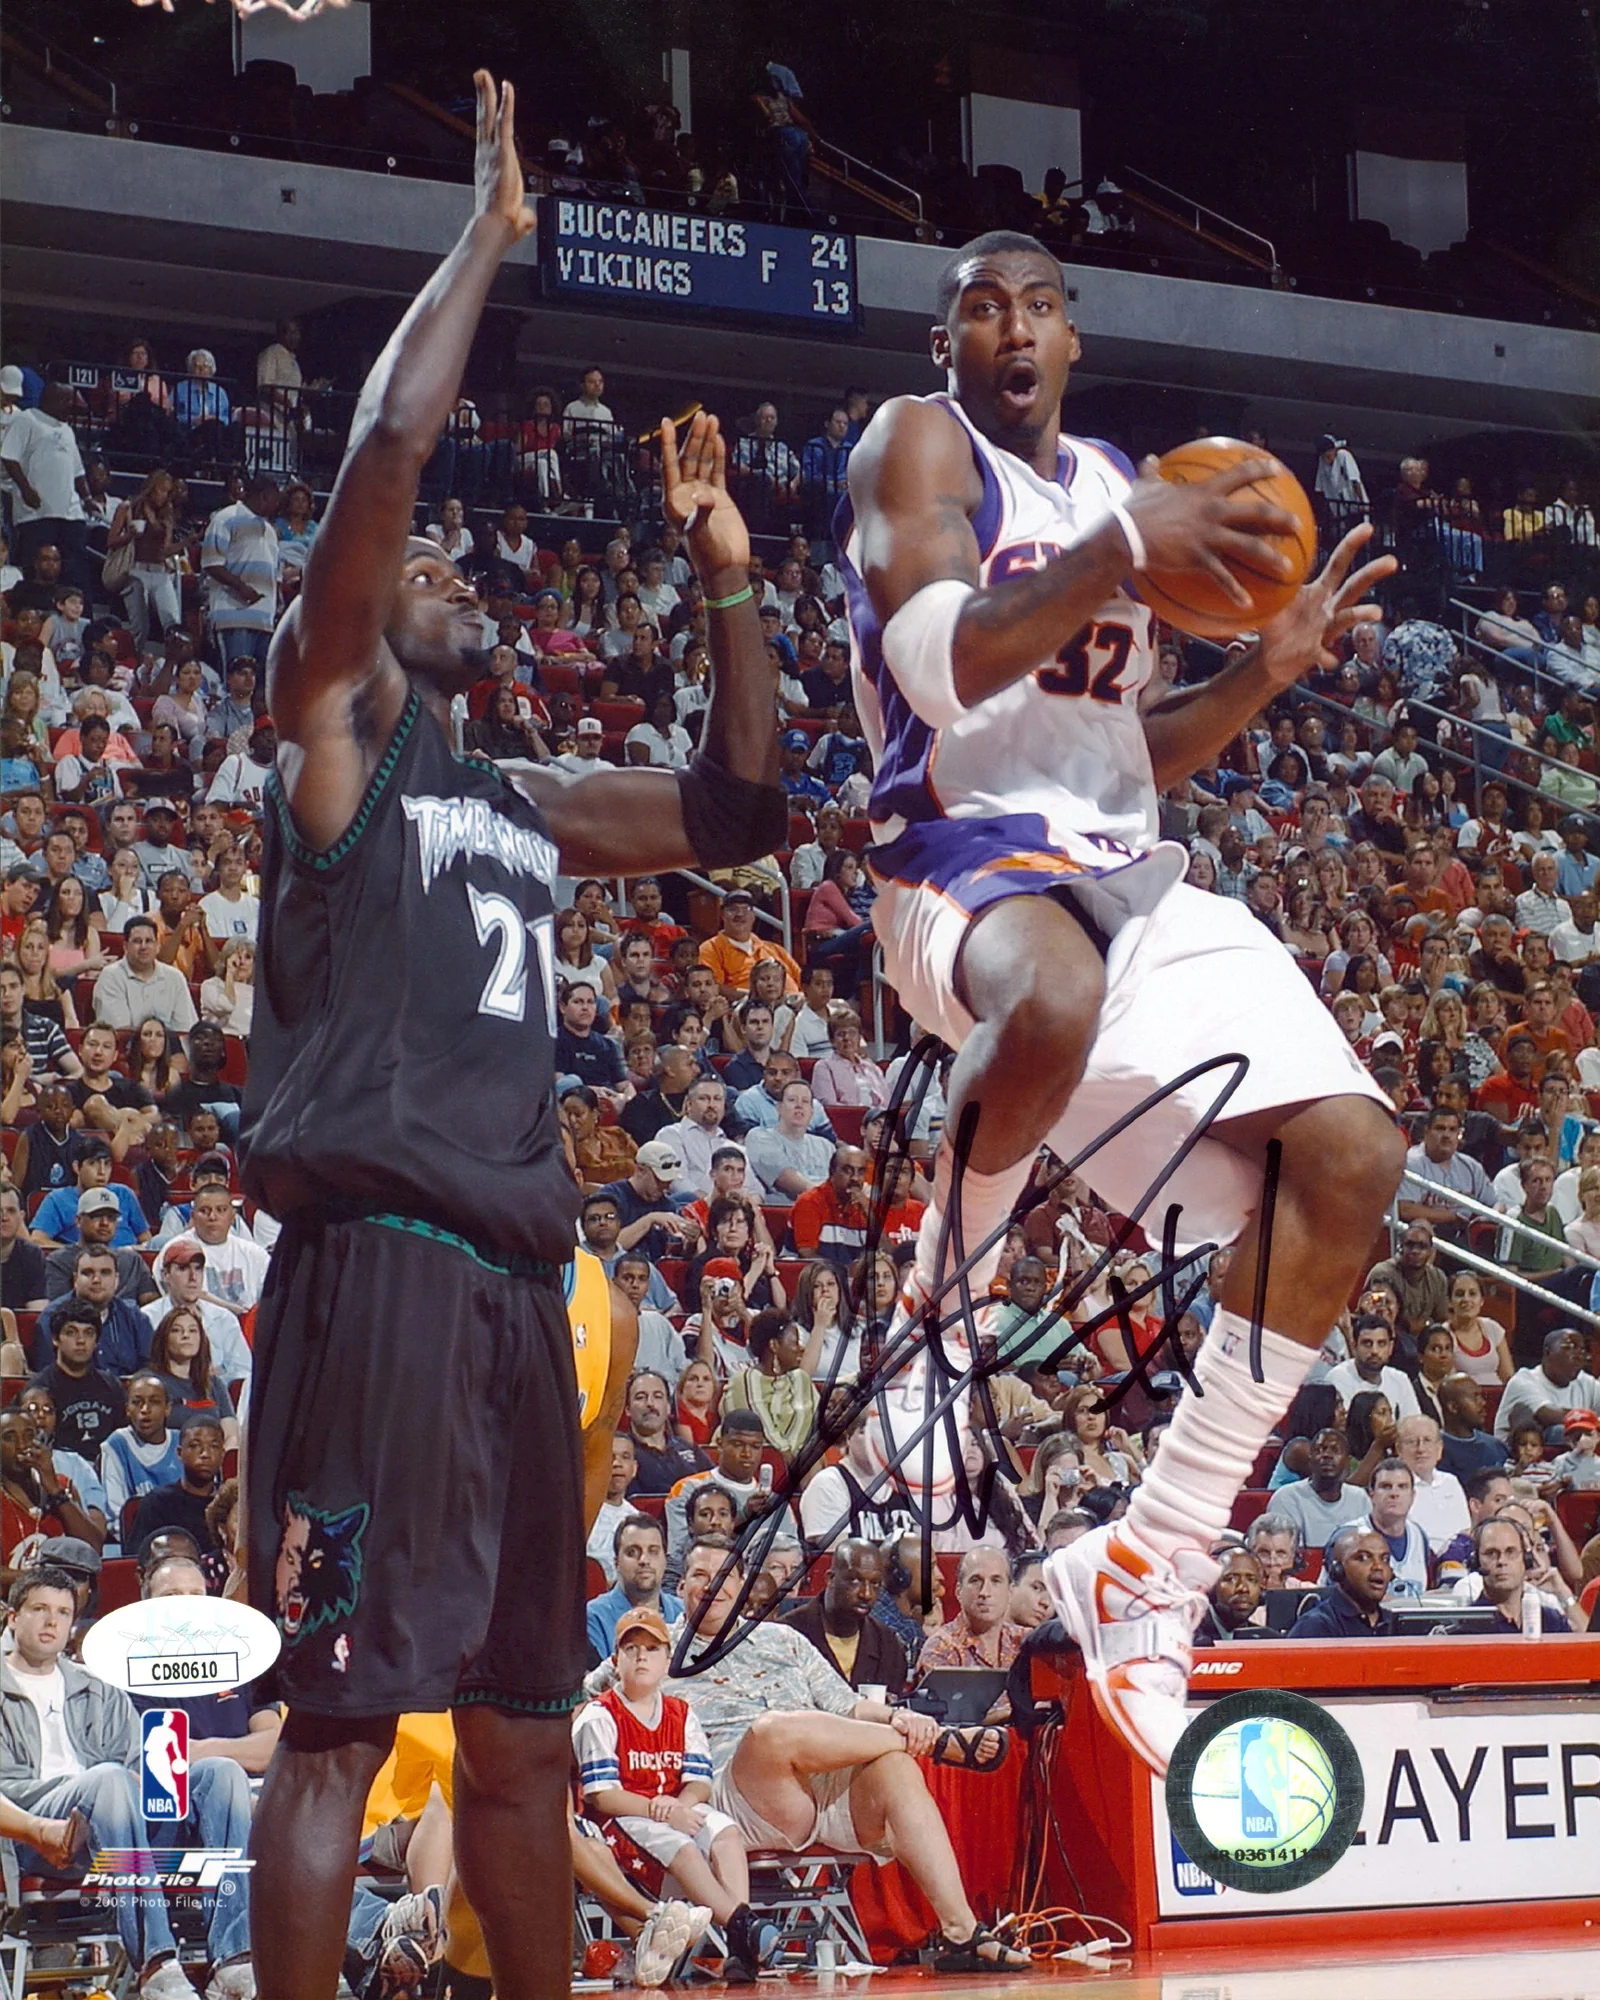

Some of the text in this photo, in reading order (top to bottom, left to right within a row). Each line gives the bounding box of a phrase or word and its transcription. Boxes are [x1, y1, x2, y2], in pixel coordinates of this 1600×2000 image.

[558, 201, 746, 257] BUCCANEERS
[761, 250, 778, 283] F
[811, 234, 848, 270] 24
[557, 247, 692, 296] VIKINGS
[812, 278, 850, 314] 13
[76, 368, 92, 383] 121
[466, 882, 558, 1039] 21
[62, 1400, 112, 1422] JORDAN
[76, 1411, 99, 1429] 13
[1192, 1662, 1244, 1675] ANC
[628, 1749, 683, 1770] ROCKES
[1351, 1743, 1600, 1846] AYER
